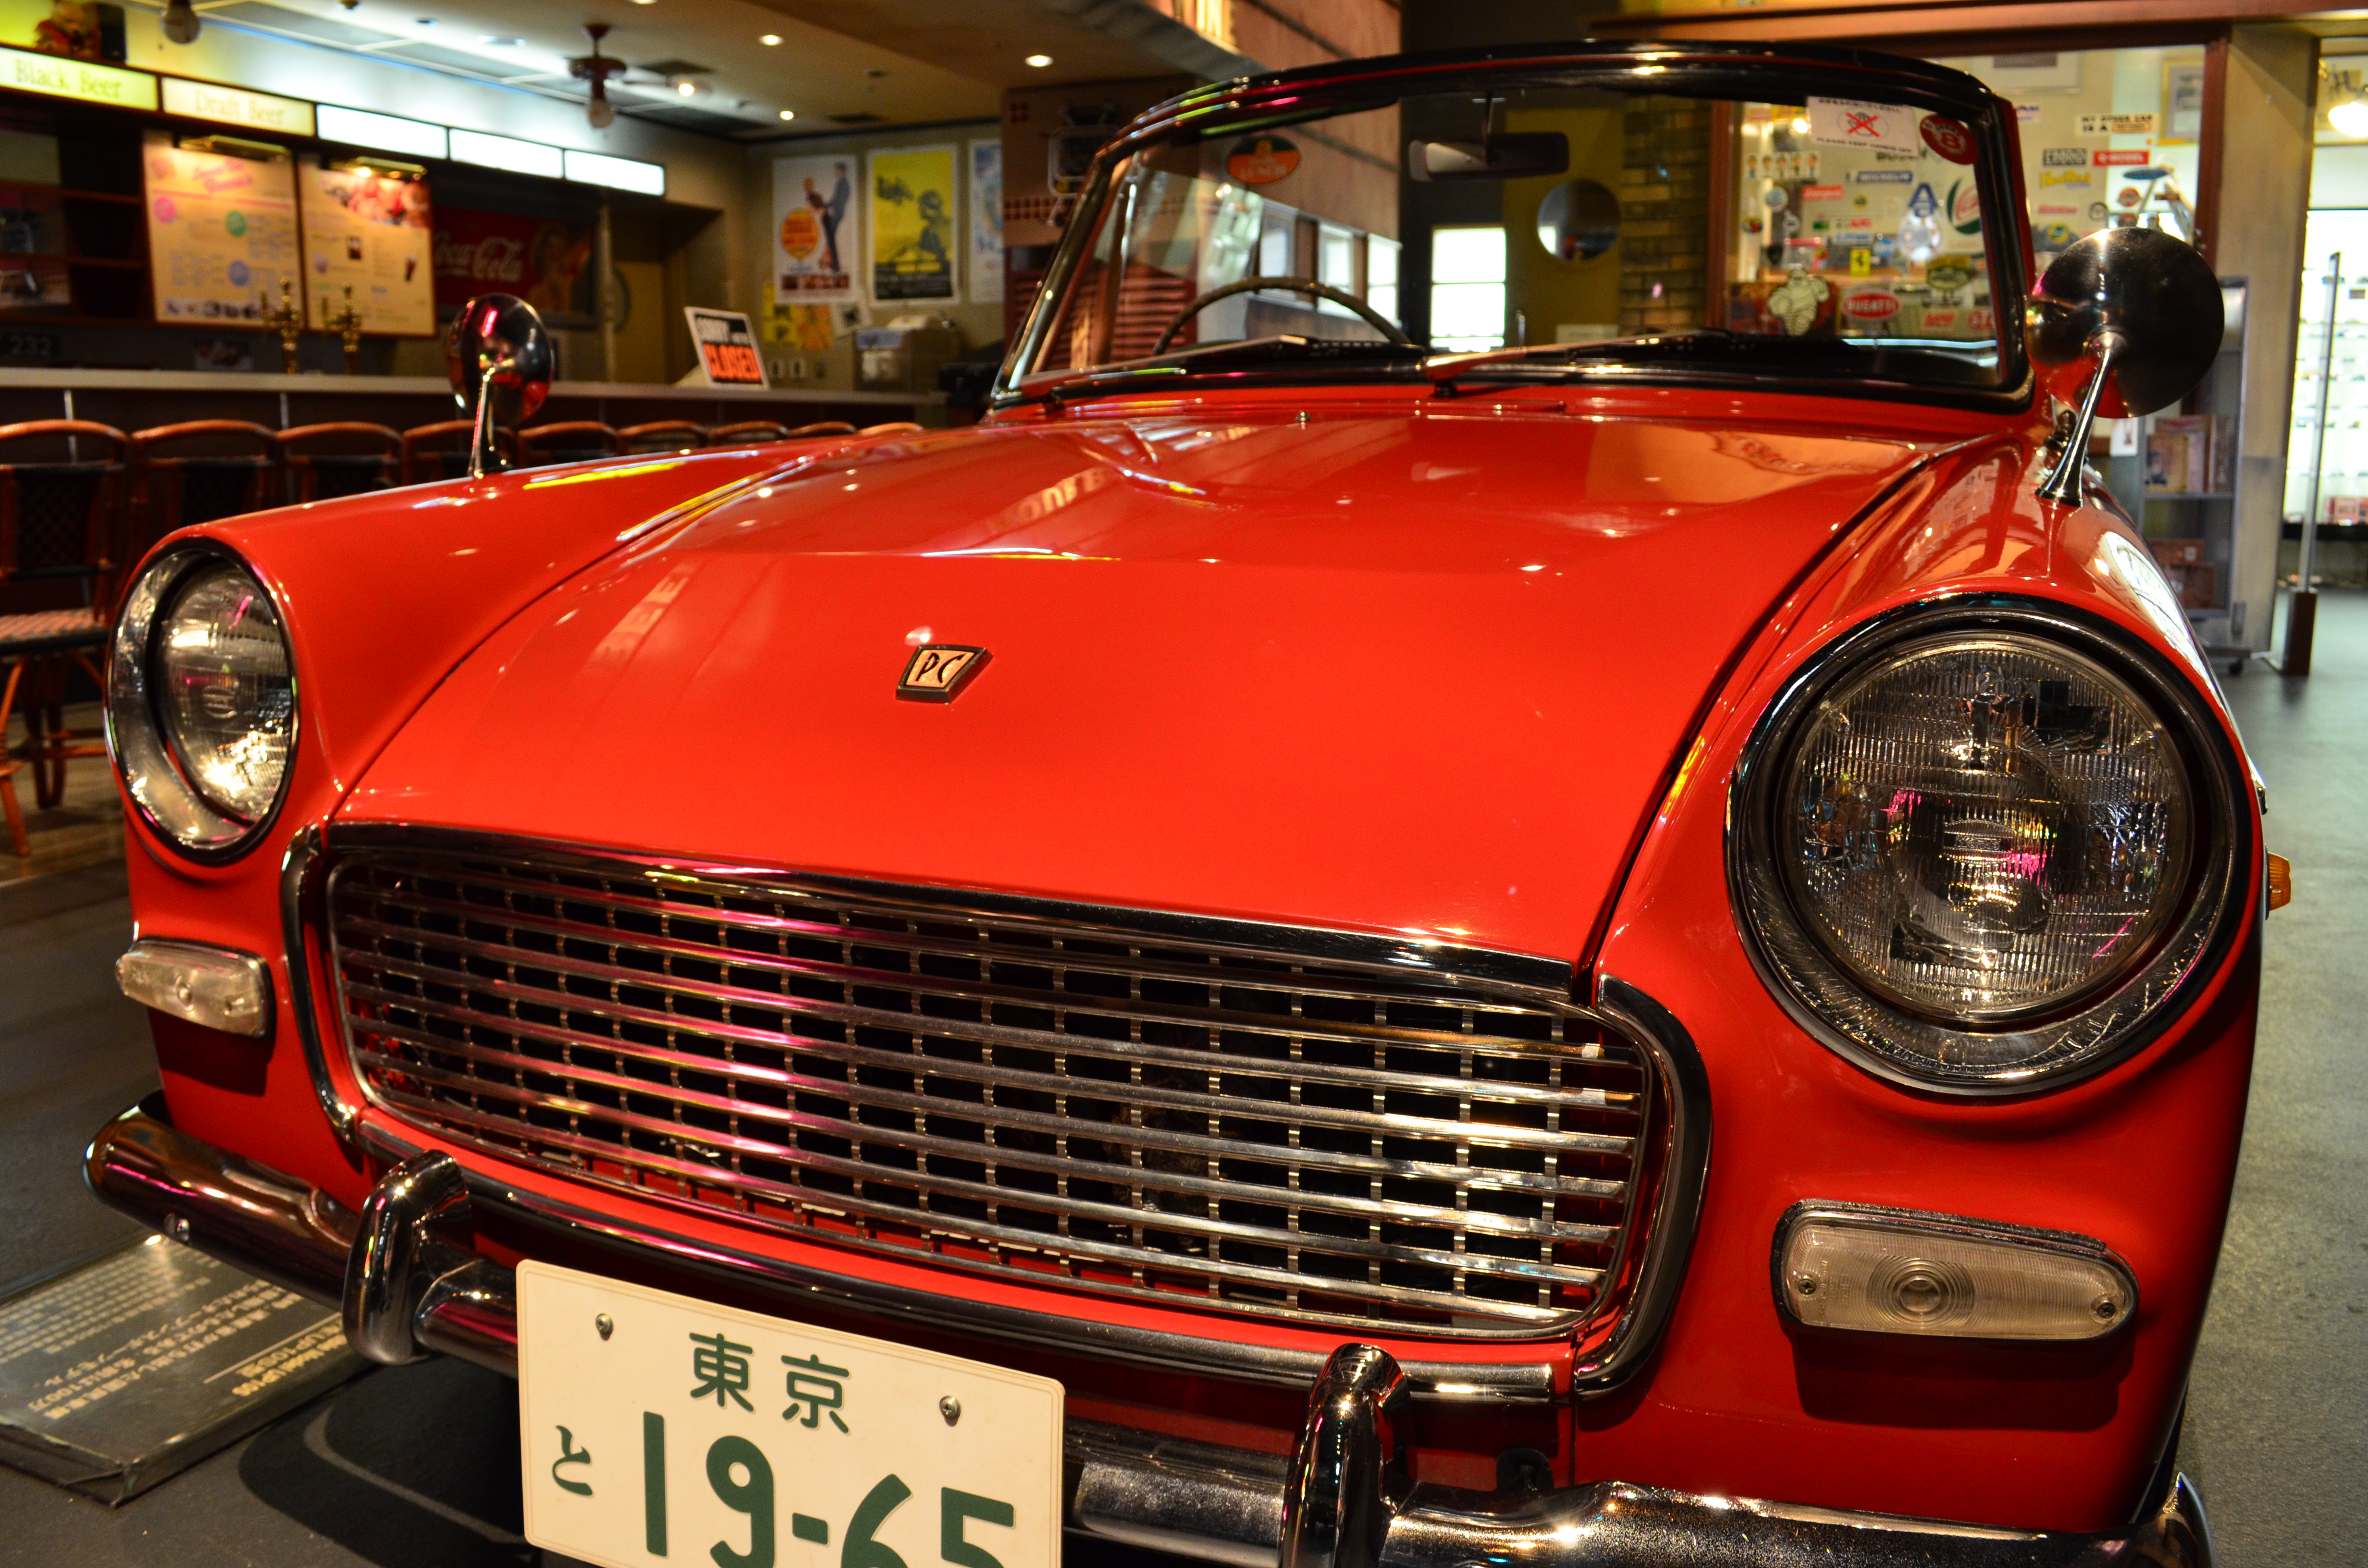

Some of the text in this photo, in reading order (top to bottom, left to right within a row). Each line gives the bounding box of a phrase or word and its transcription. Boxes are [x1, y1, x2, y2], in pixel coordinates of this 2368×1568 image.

[14, 59, 122, 99] Black Beer
[195, 90, 285, 125] Draft Beer
[703, 342, 763, 381] CLOSED
[915, 652, 967, 684] PC
[689, 1333, 850, 1433] 東京
[552, 1411, 1014, 1568] と 19-65
